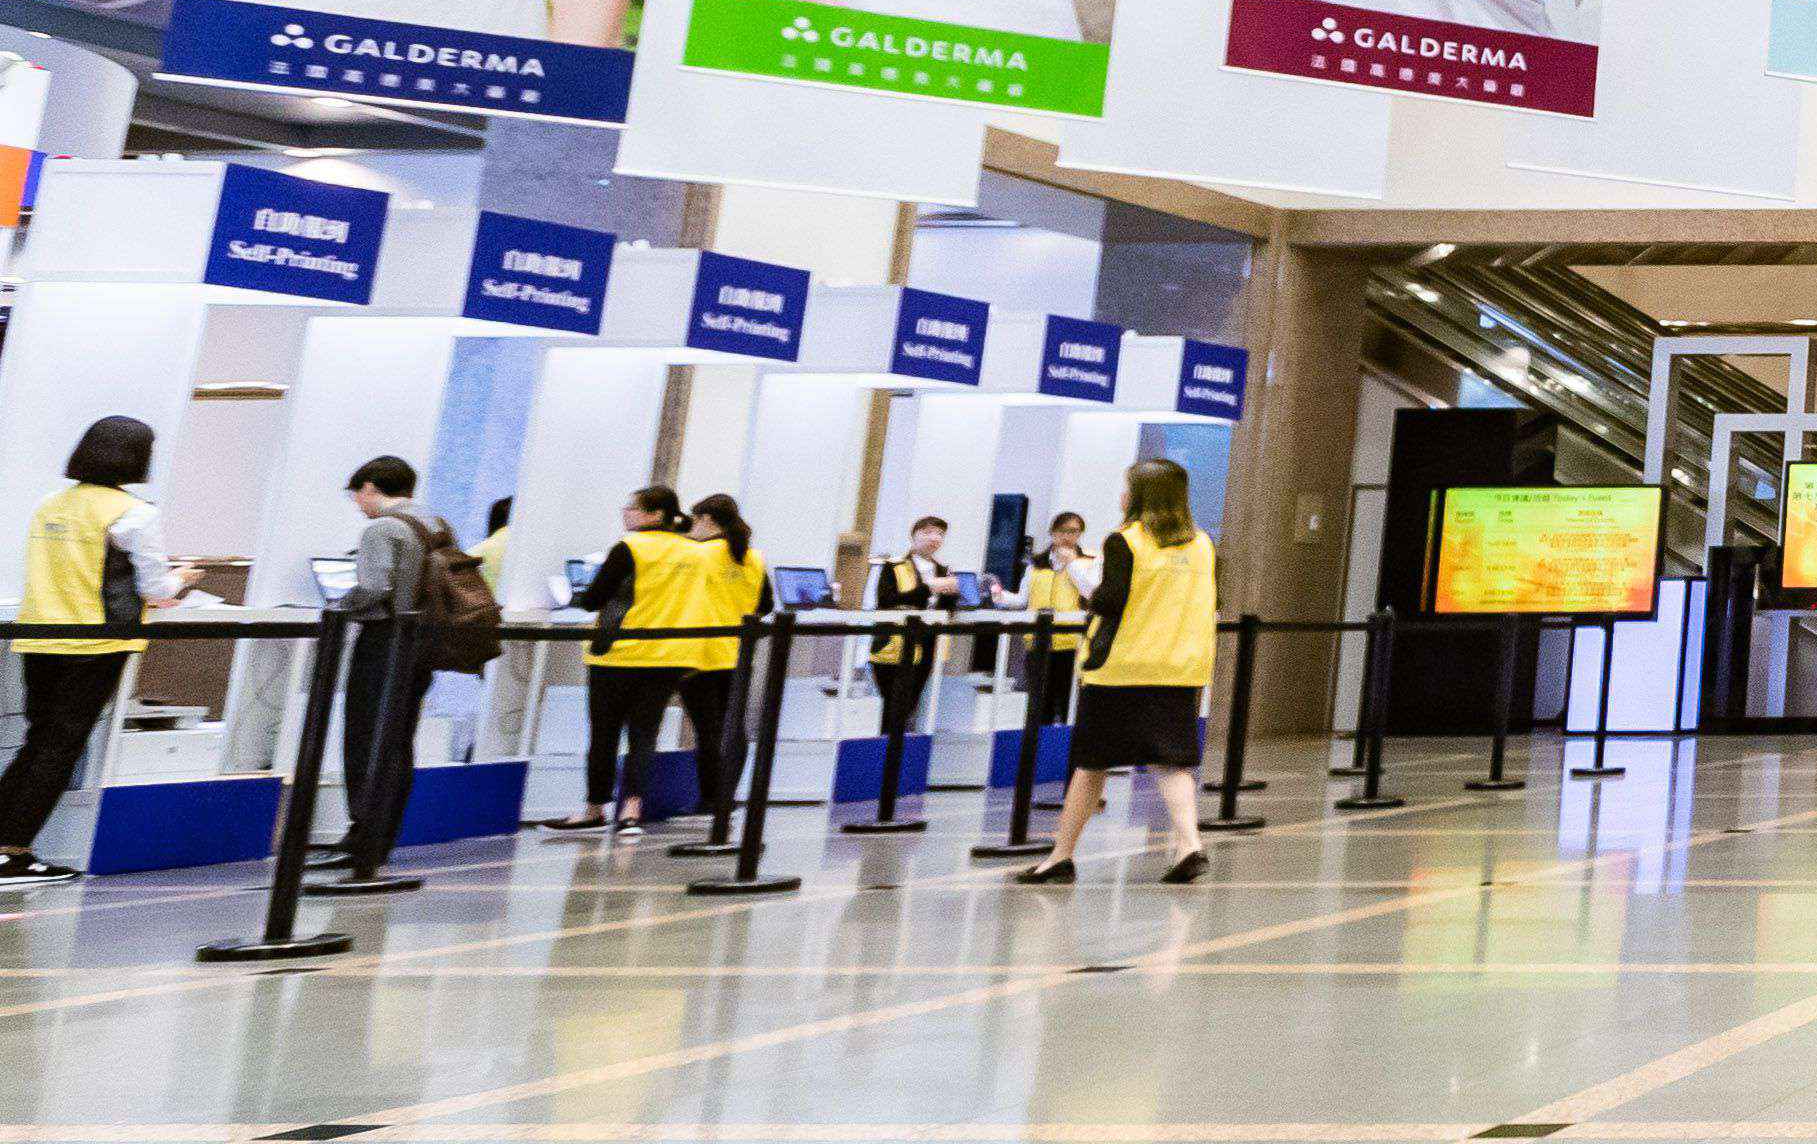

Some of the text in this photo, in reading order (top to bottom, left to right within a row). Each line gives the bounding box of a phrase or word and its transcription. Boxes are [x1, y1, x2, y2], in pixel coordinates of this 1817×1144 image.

[323, 33, 546, 78] GALDERMA
[830, 25, 1029, 71] GALDERMA
[1353, 26, 1528, 72] GALDERMA
[227, 239, 361, 281] Self-Printing
[481, 277, 592, 315] Self-Printing
[699, 310, 792, 343] Self-Printing
